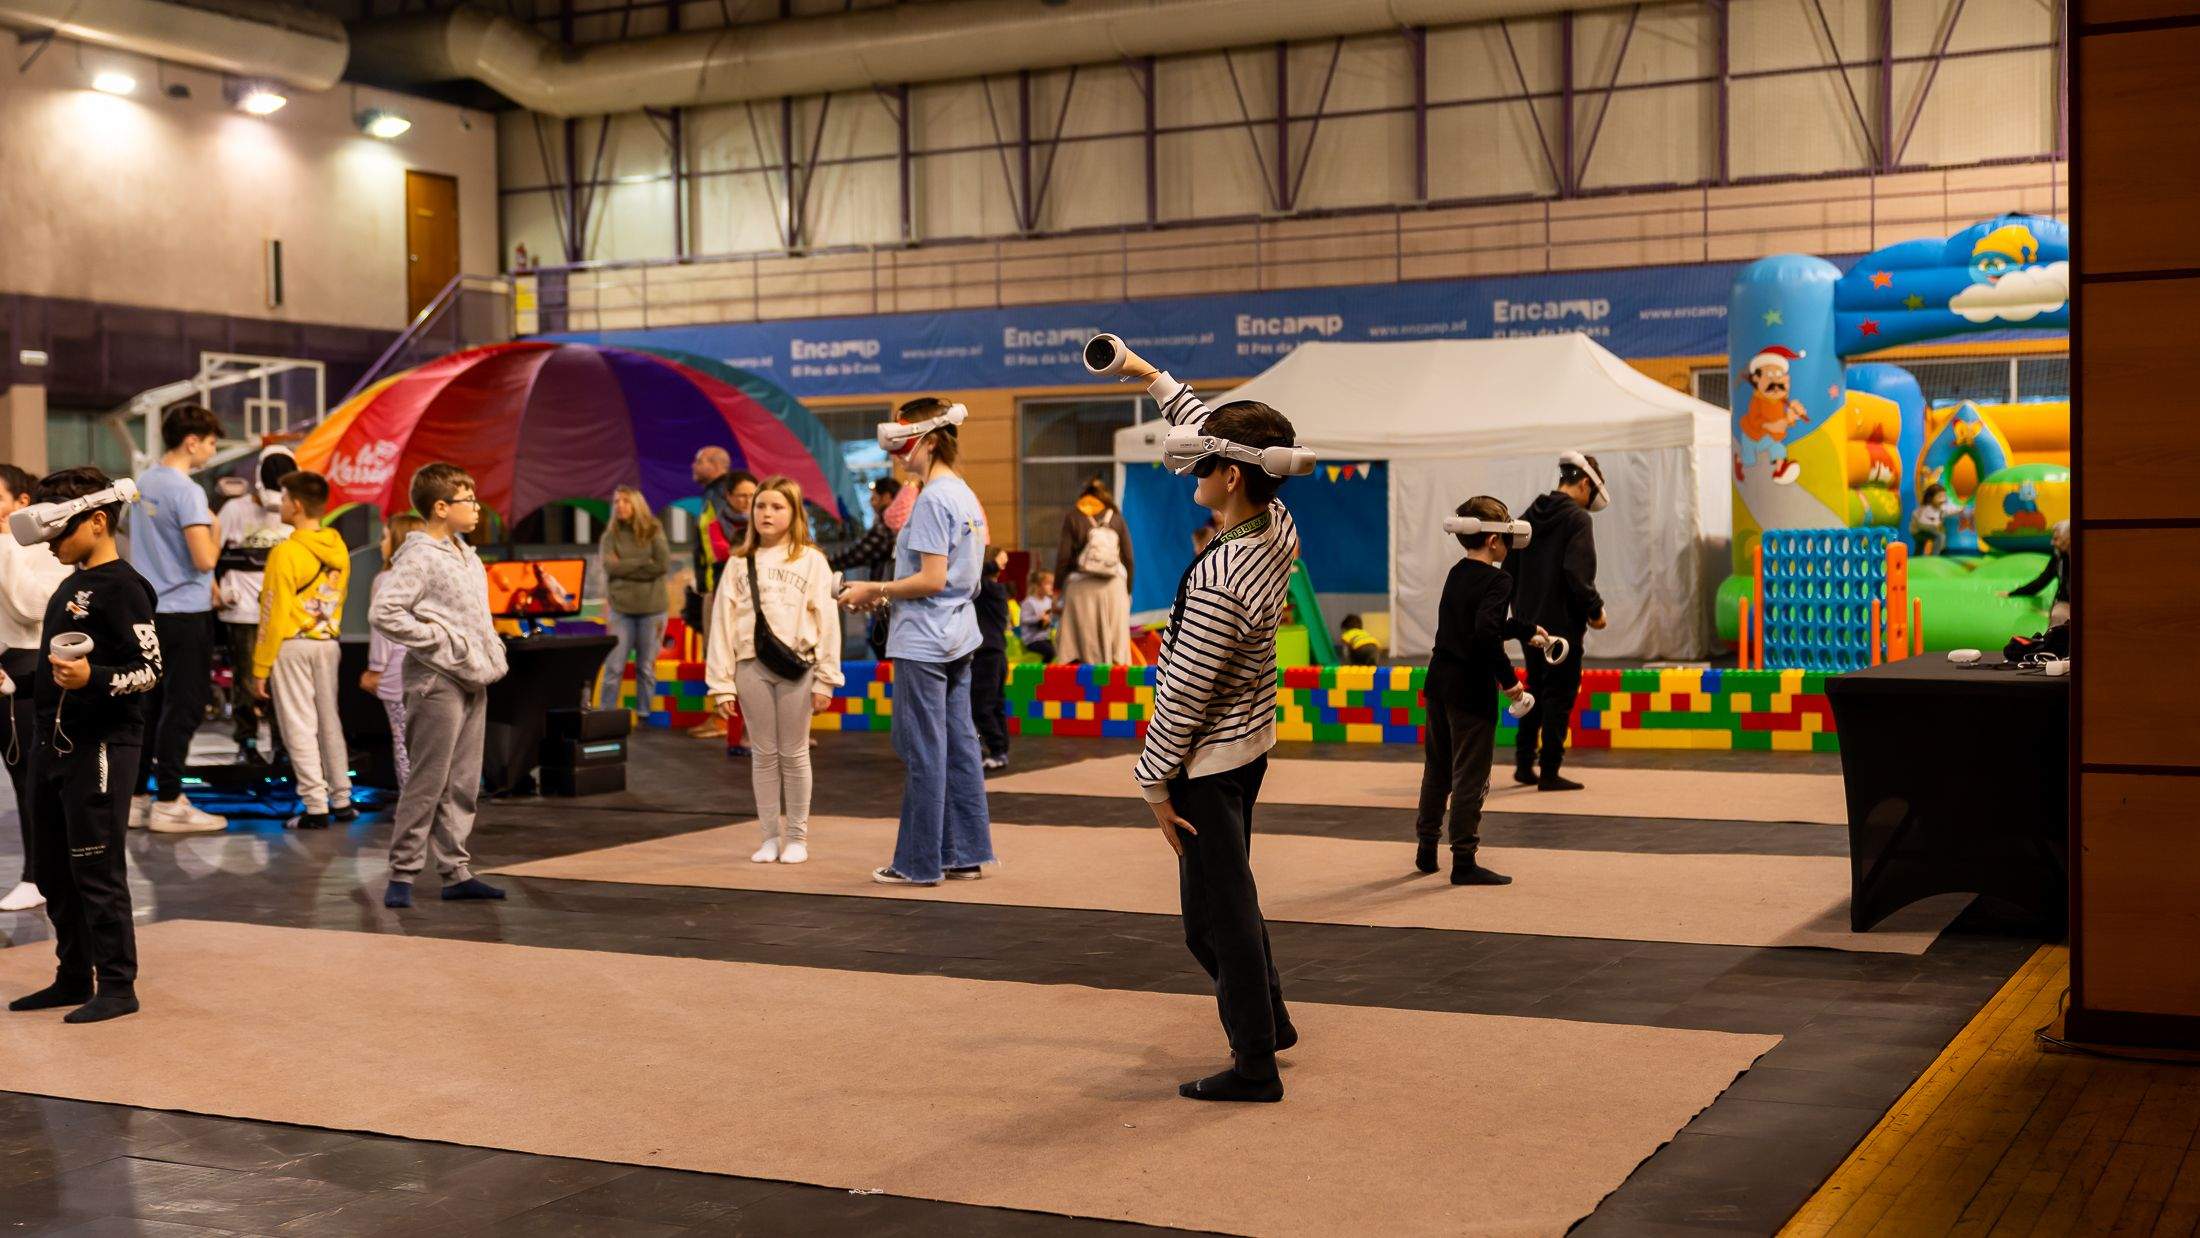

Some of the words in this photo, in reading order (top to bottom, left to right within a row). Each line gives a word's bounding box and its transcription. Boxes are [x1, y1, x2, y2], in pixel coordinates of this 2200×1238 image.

[1494, 299, 1610, 322] Encamp
[1640, 305, 1728, 319] www.encamp
[1236, 314, 1343, 336] Encamp
[1369, 319, 1467, 336] www.encamp.ad
[791, 339, 880, 360] Encamp
[1221, 516, 1268, 544] ARTREUSE
